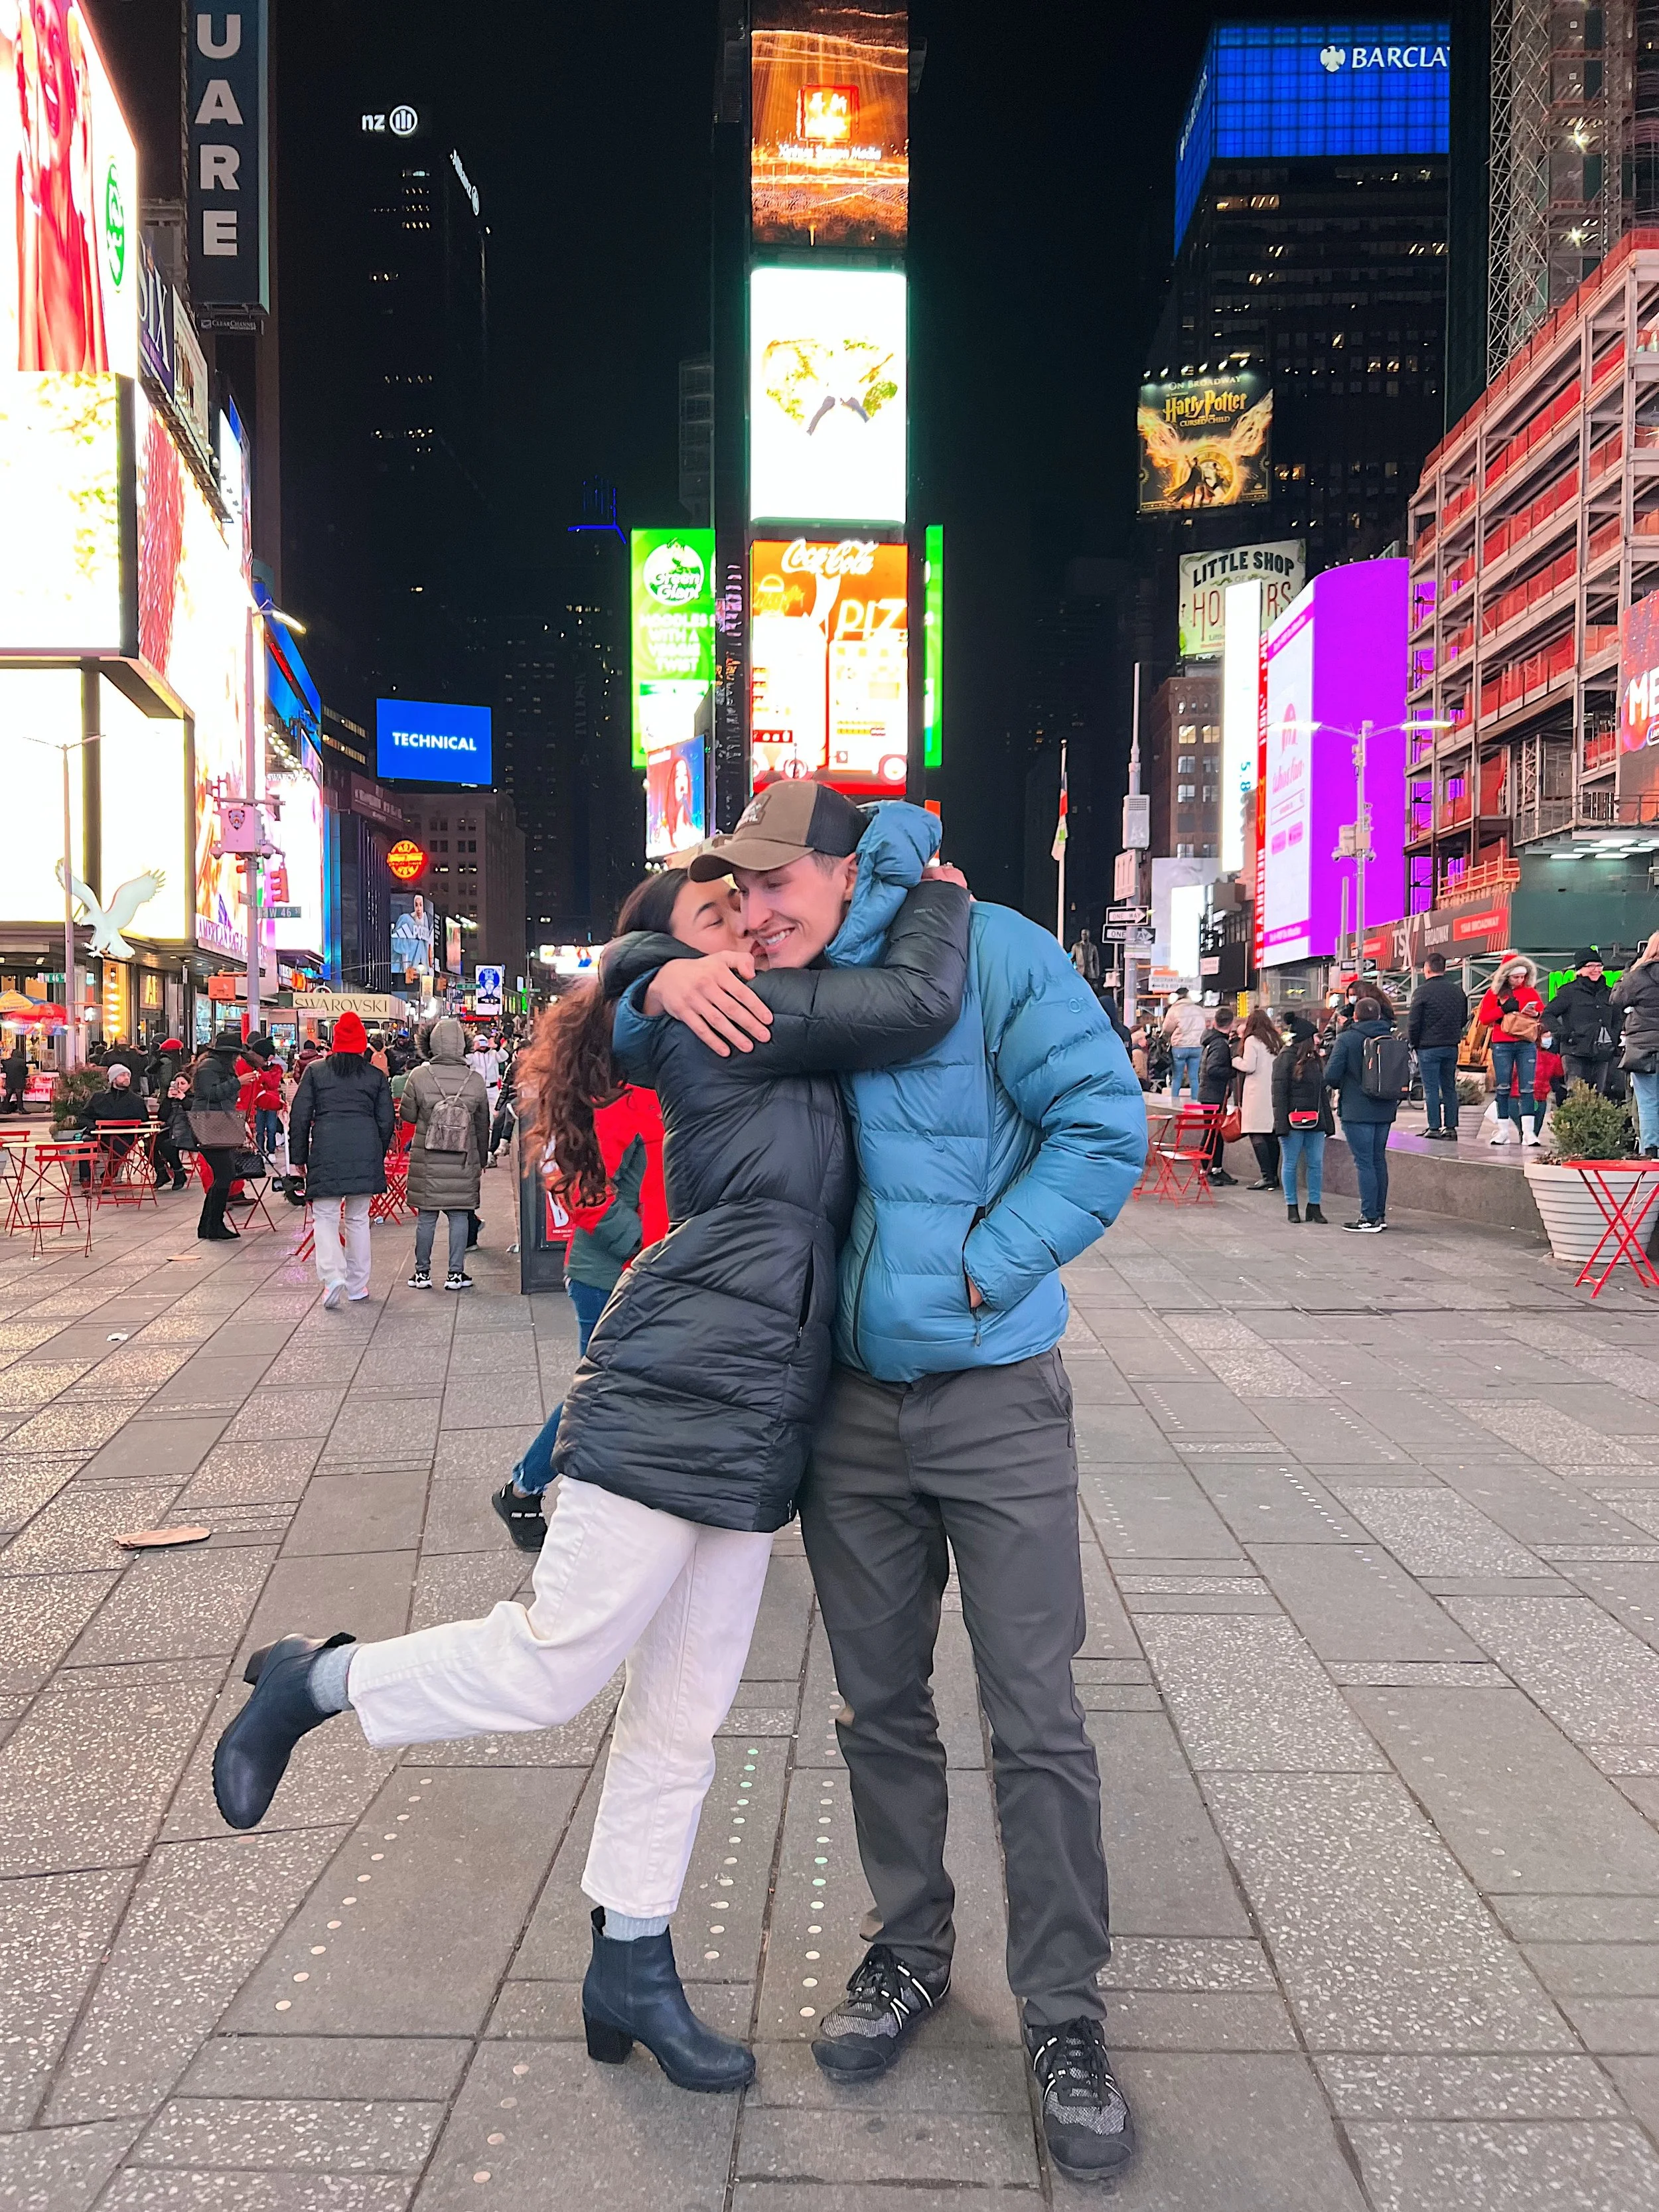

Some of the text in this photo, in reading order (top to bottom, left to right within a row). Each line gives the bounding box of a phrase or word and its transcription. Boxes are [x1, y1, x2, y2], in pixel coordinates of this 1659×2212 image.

[1352, 46, 1450, 68] BARCLA
[362, 114, 385, 131] nz
[1168, 375, 1241, 390] ON BROADWAY
[1163, 390, 1248, 423] Harry Potter
[1180, 417, 1208, 427] CURSED
[1193, 551, 1295, 589] LITTLE SHOP
[1192, 581, 1293, 642] HORS
[392, 732, 477, 751] TECHNICAL
[1256, 849, 1265, 942] HERSHEY'S
[269, 907, 277, 917] W
[281, 907, 292, 917] 46
[1392, 919, 1412, 967] TSX
[1424, 924, 1449, 947] BROADWAY
[295, 998, 387, 1012] SWAROVSKI
